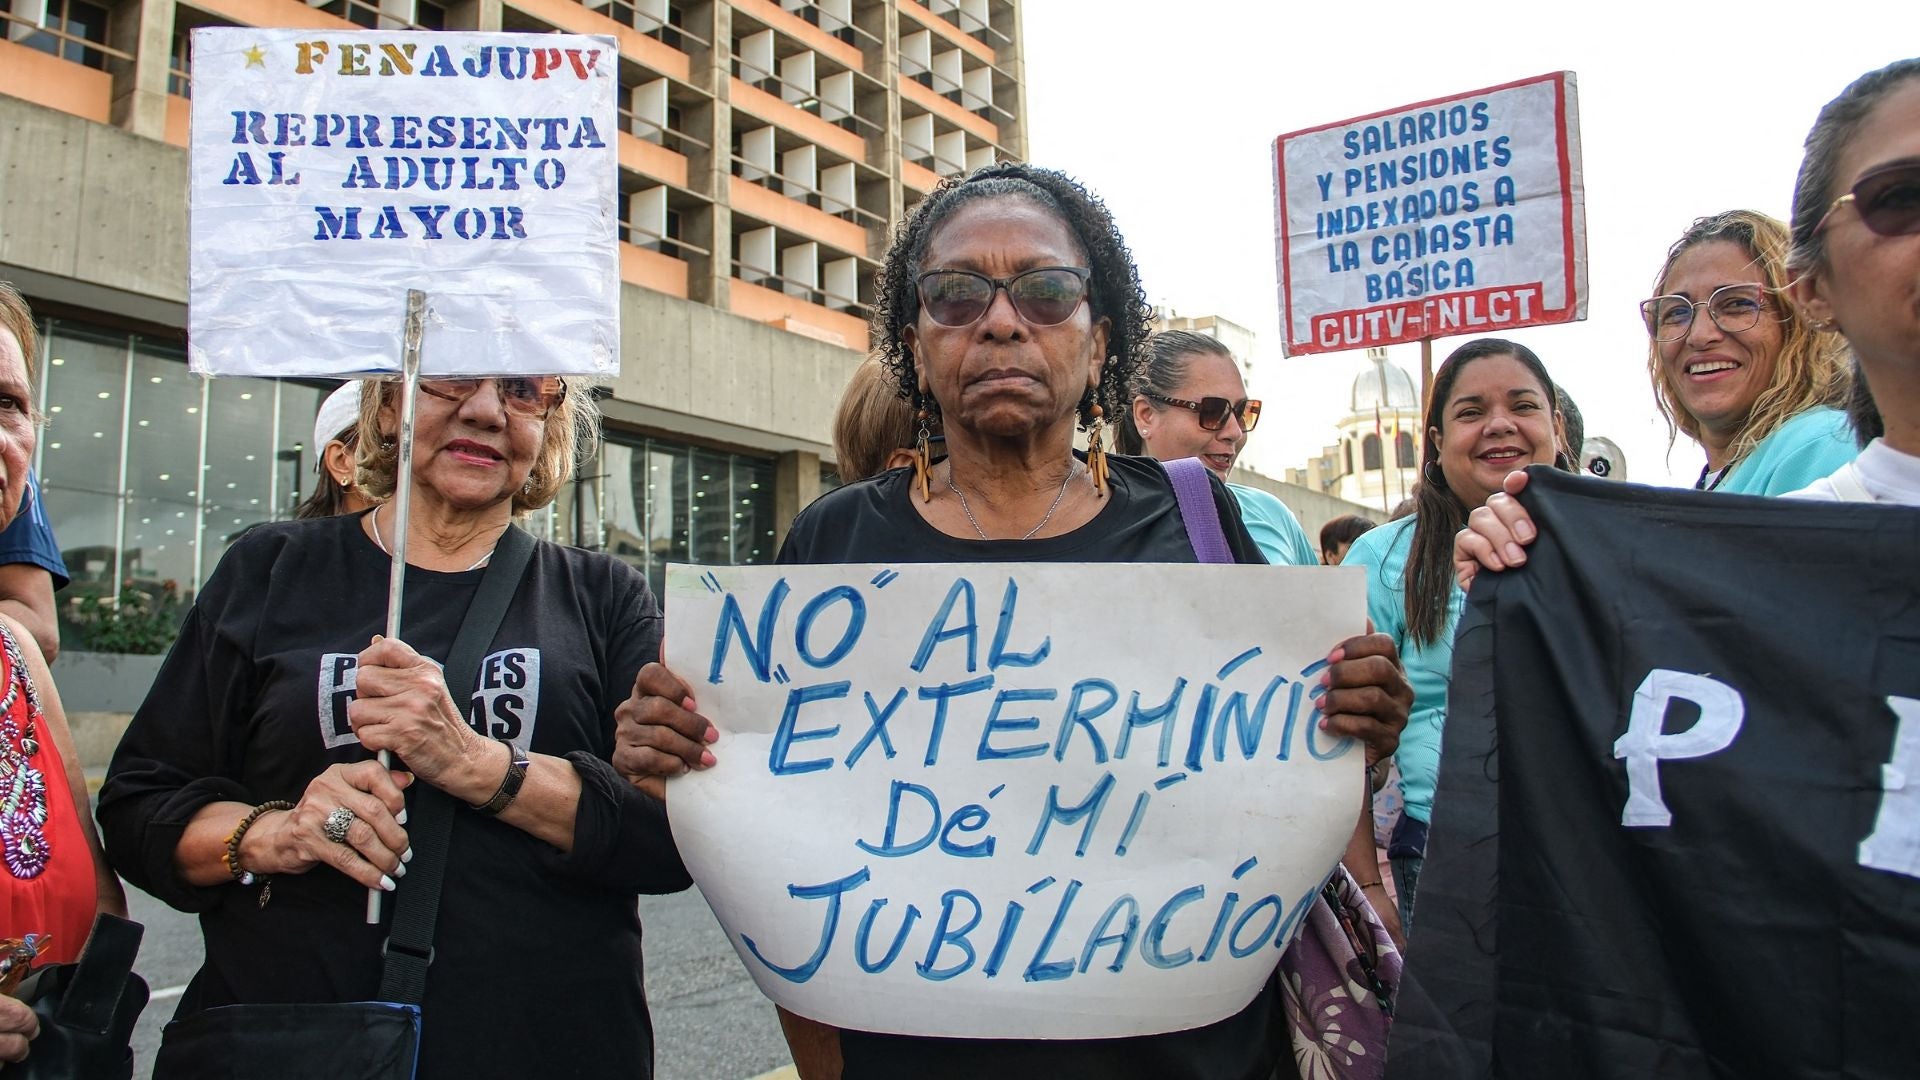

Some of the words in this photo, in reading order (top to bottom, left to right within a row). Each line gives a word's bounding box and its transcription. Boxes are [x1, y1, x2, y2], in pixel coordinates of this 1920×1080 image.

[295, 40, 600, 80] FENAJUPV
[230, 110, 606, 150] REPRESENTA
[1343, 101, 1489, 160] SALARIOS
[222, 151, 300, 185] AL
[341, 155, 566, 191] ADULTO
[1316, 171, 1333, 202] Y
[1345, 135, 1512, 197] PENSIONES
[313, 205, 527, 240] MAYOR
[1316, 182, 1480, 240] INDEXADOS
[1494, 175, 1516, 207] A
[1327, 241, 1360, 273] LA
[1371, 213, 1514, 265] CANASTA
[1365, 258, 1475, 303] BÁSICA
[910, 577, 1051, 673] AL
